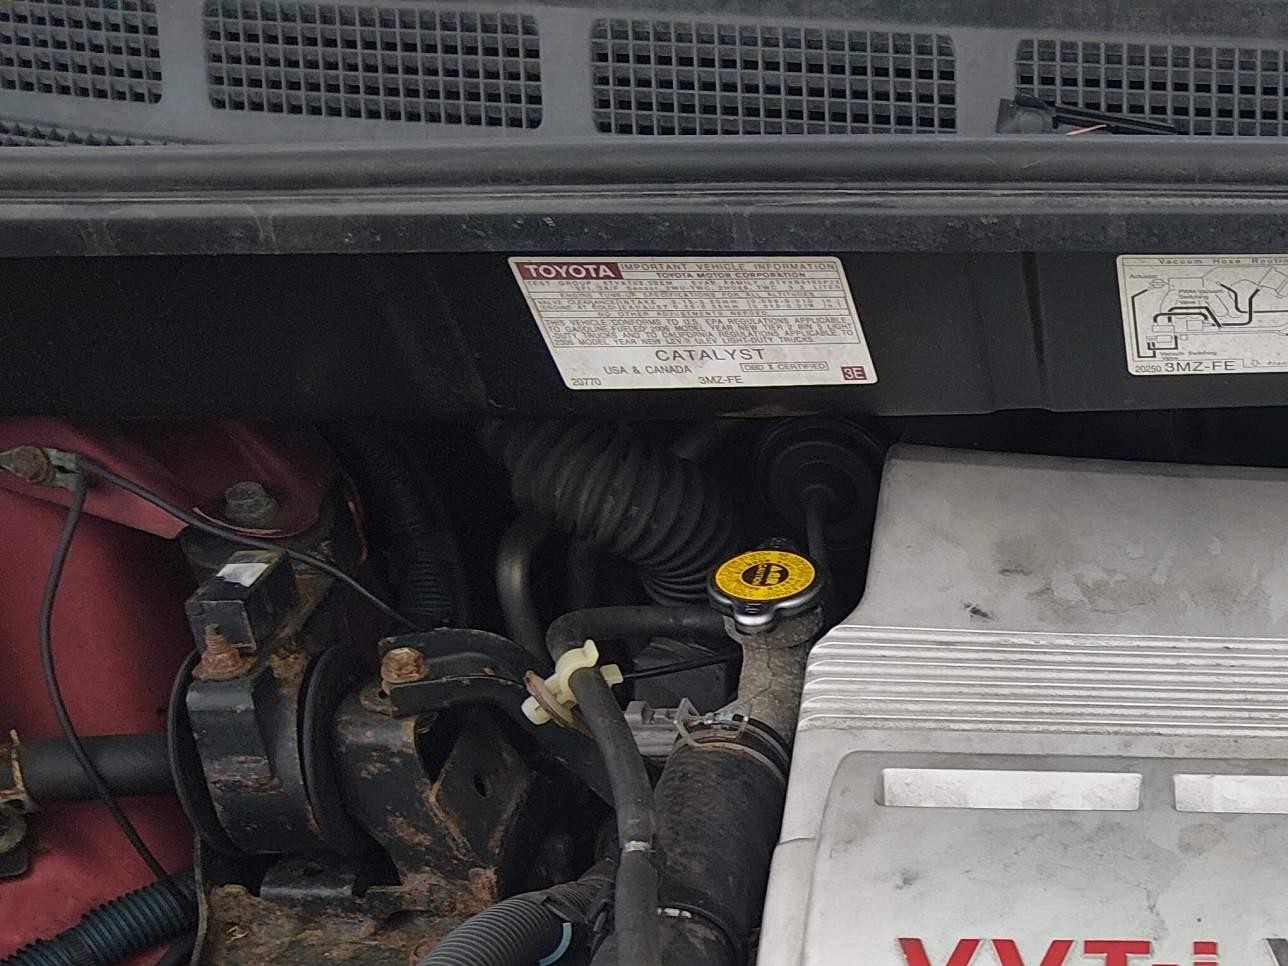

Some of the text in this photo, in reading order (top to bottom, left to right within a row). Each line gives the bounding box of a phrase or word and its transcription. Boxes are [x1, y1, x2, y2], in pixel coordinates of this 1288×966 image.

[1213, 257, 1241, 265] Hose
[524, 265, 616, 278] TOYOTA
[620, 263, 835, 271] IMPORTANT VEHICLE INFORMATION
[674, 324, 705, 332] MODEL
[622, 331, 640, 339] AND
[718, 330, 780, 338] REGULATIONS
[655, 349, 766, 362] CATALYST
[603, 365, 693, 375] USA & CANADA
[744, 363, 763, 371] OBD
[777, 362, 827, 370] CERTIFIED
[1135, 360, 1237, 374] 20250 3MZ-FE
[844, 367, 865, 380] 3E
[571, 375, 744, 386] 20770 3MZ-FE
